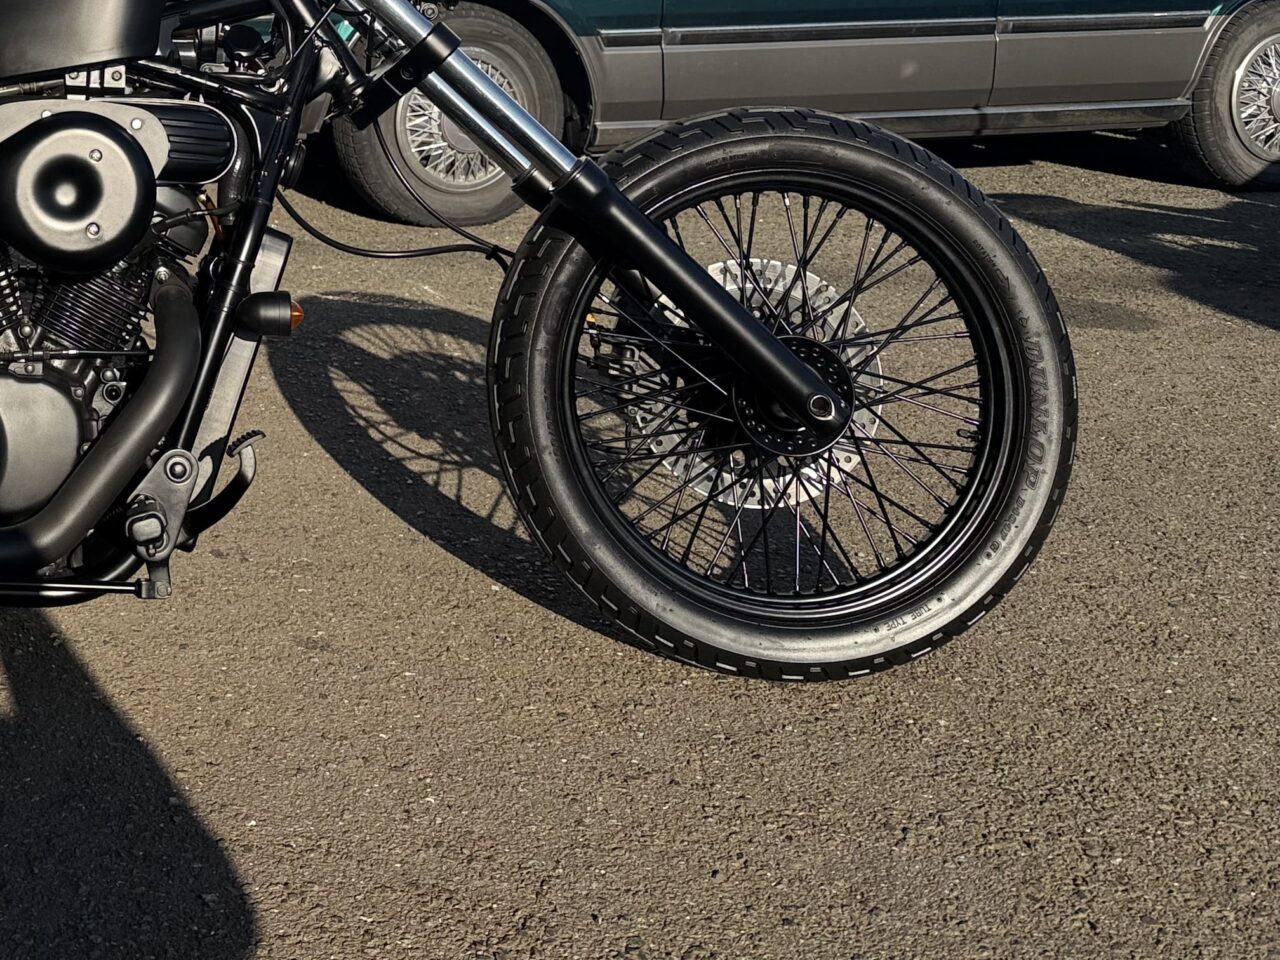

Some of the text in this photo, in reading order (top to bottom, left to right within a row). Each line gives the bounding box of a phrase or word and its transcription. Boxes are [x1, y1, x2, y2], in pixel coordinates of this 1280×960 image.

[1022, 337, 1049, 490] DUNLOP
[883, 603, 932, 631] TUBE TYPE
